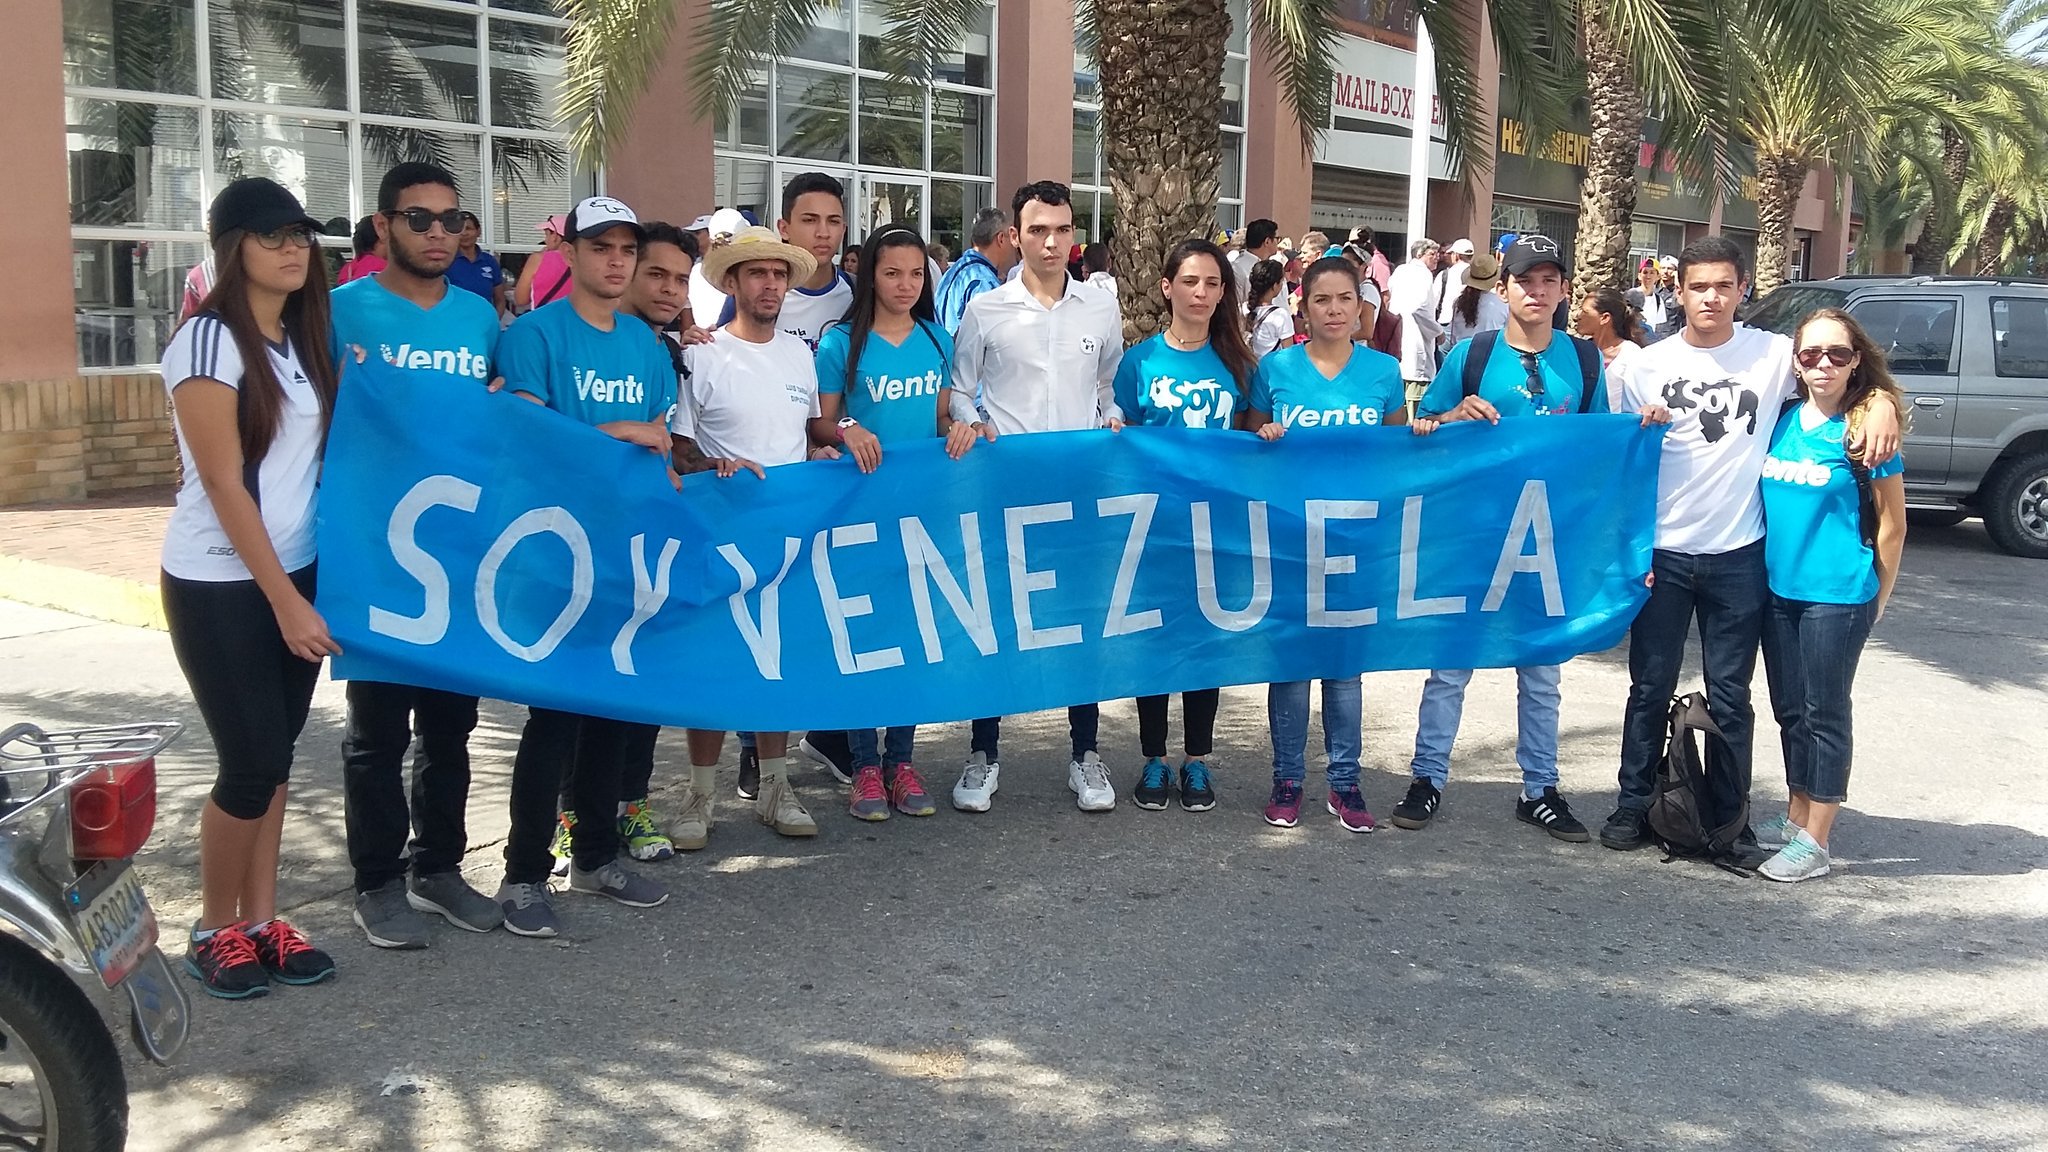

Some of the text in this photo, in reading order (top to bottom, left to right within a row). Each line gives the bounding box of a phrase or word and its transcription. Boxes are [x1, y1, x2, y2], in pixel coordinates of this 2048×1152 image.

[1335, 72, 1378, 113] MAIL
[1380, 83, 1415, 120] BOX
[380, 342, 488, 379] Vente
[1282, 403, 1380, 429] Vente
[1761, 457, 1832, 487] ente
[369, 474, 1567, 681] SOY VENEZUELA
